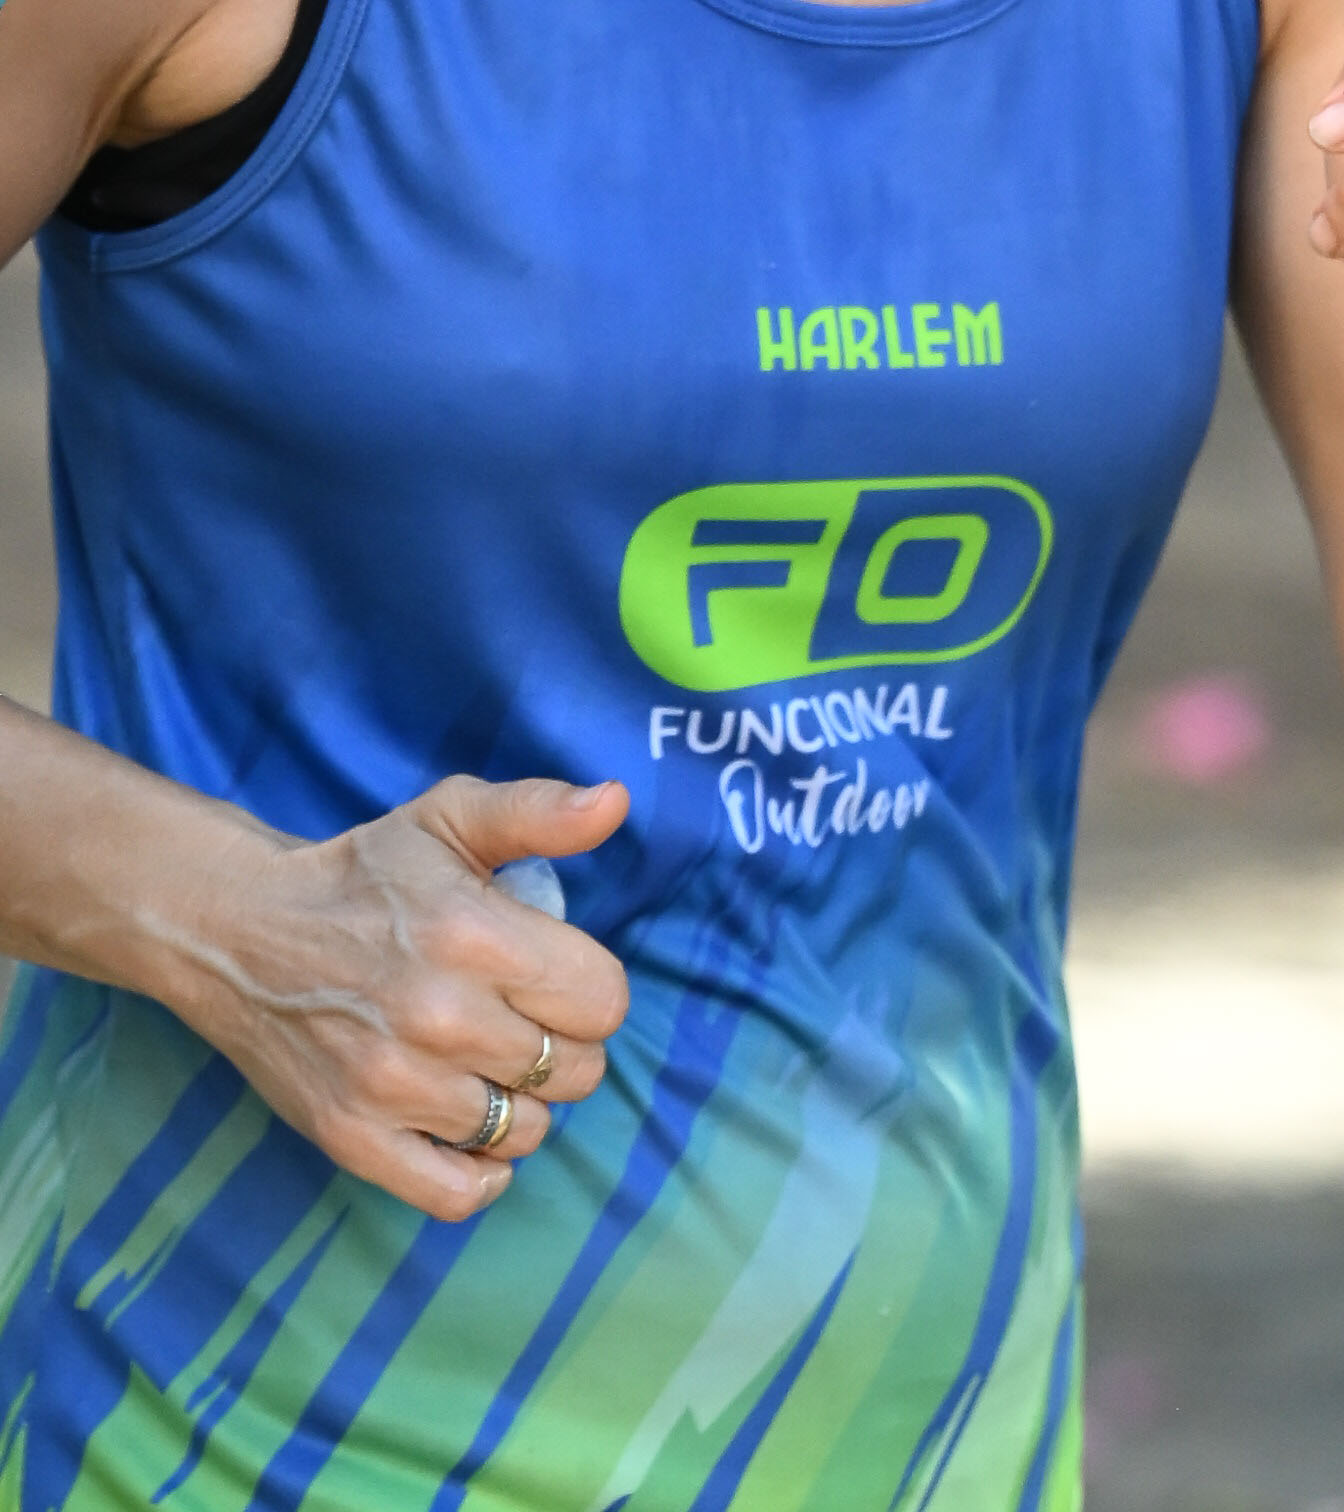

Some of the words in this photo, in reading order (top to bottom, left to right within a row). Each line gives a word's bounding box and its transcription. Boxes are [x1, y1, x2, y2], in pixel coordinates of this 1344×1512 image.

[756, 302, 1004, 372] HARLEM
[649, 682, 953, 760] FUNCIONAL
[718, 758, 931, 854] Outdoor
